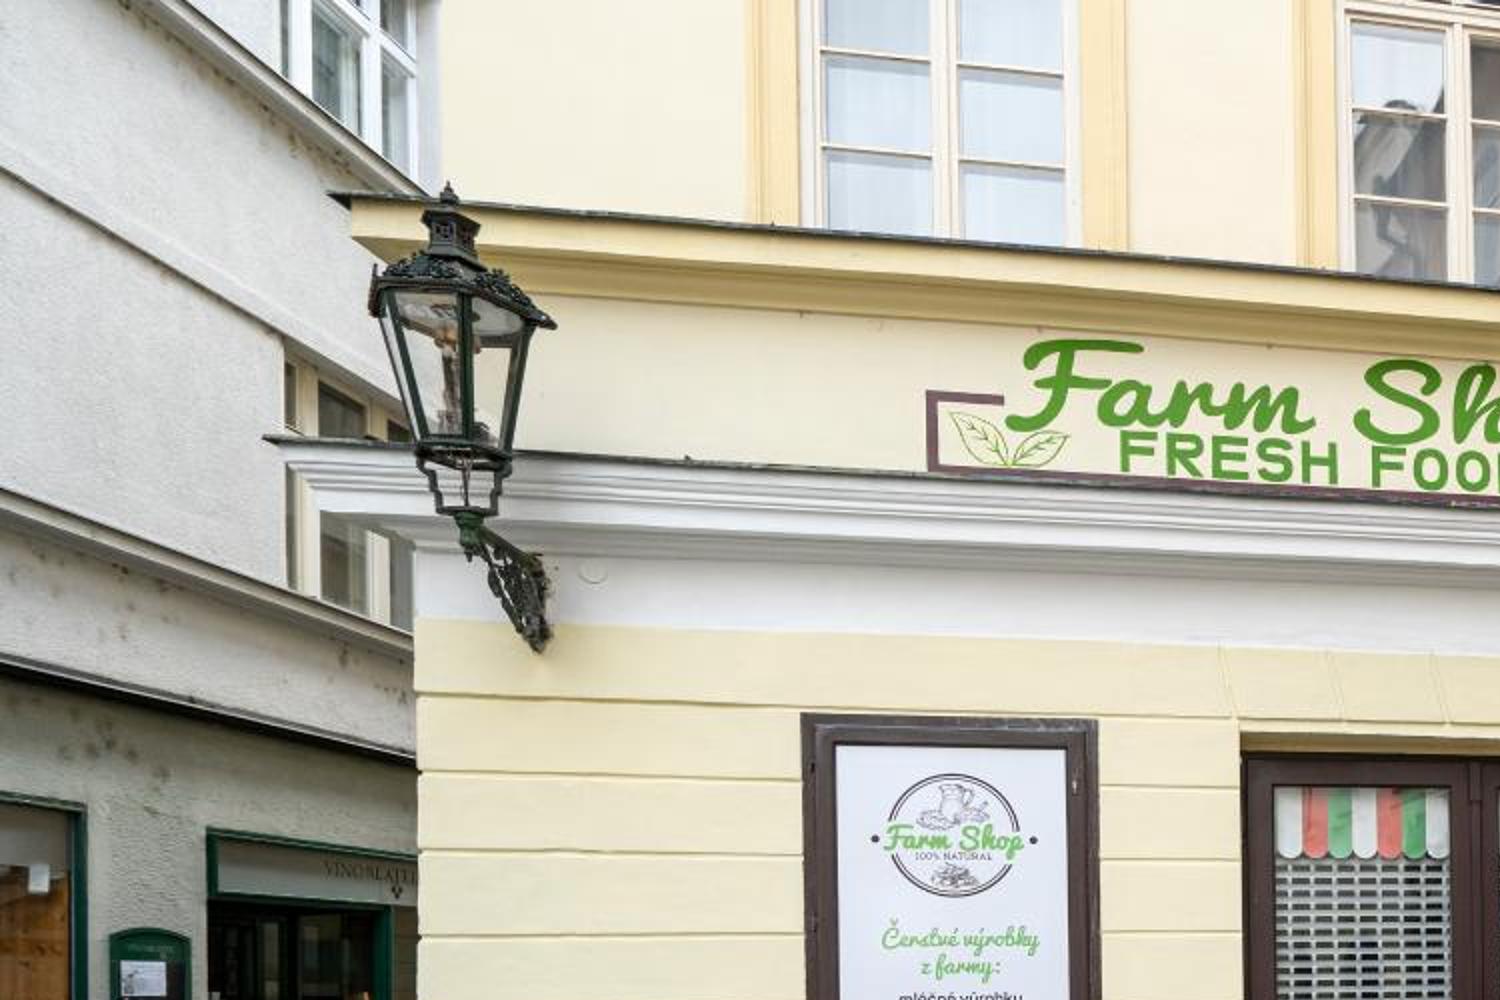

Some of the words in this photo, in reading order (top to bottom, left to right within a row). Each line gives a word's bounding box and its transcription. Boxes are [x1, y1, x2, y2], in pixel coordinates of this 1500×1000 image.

[1005, 338, 1316, 435] Farm
[1119, 429, 1340, 486] FRESH
[883, 824, 951, 851] Farm
[959, 823, 1025, 861] Shop
[943, 852, 993, 861] NATURAL
[921, 962, 931, 975] z
[935, 953, 1001, 984] farmy:
